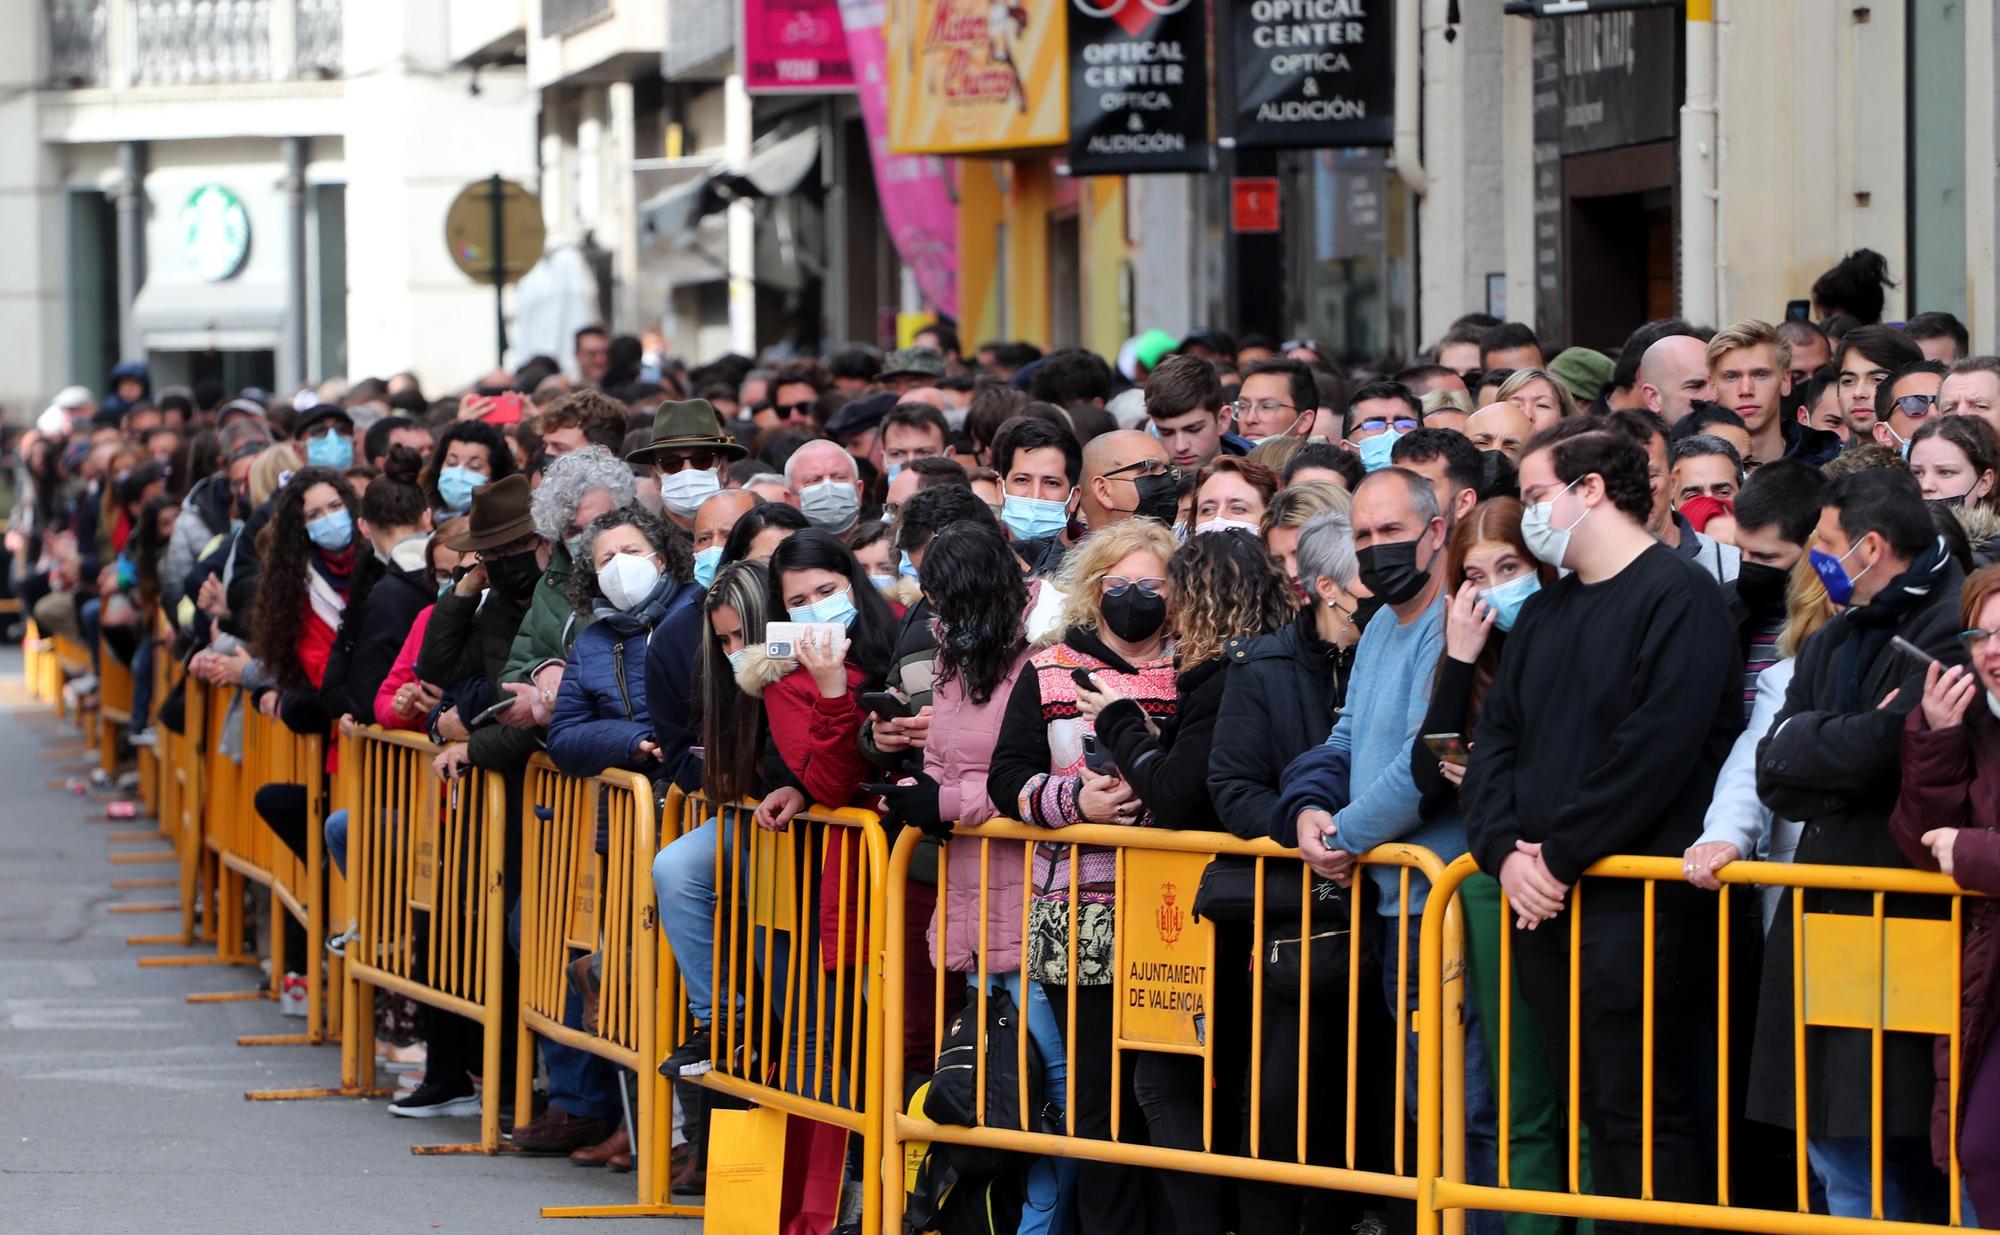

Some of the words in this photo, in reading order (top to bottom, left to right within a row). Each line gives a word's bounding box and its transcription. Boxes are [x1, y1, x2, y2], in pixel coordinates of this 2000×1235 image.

[1251, 0, 1367, 22] OPTICAL
[1253, 22, 1364, 48] CENTER
[1083, 41, 1185, 64] OPTICAL
[1270, 52, 1350, 75] OPTICA
[1084, 65, 1183, 87] CENTER
[1302, 77, 1319, 97] &
[1256, 95, 1365, 122] AUDICIÓN
[1127, 113, 1143, 131] &
[1087, 130, 1185, 153] AUDICIÓN
[1130, 961, 1206, 984] AJUNTAMENT
[1129, 988, 1145, 1007] DE
[1149, 986, 1204, 1013] VALÈNCIA
